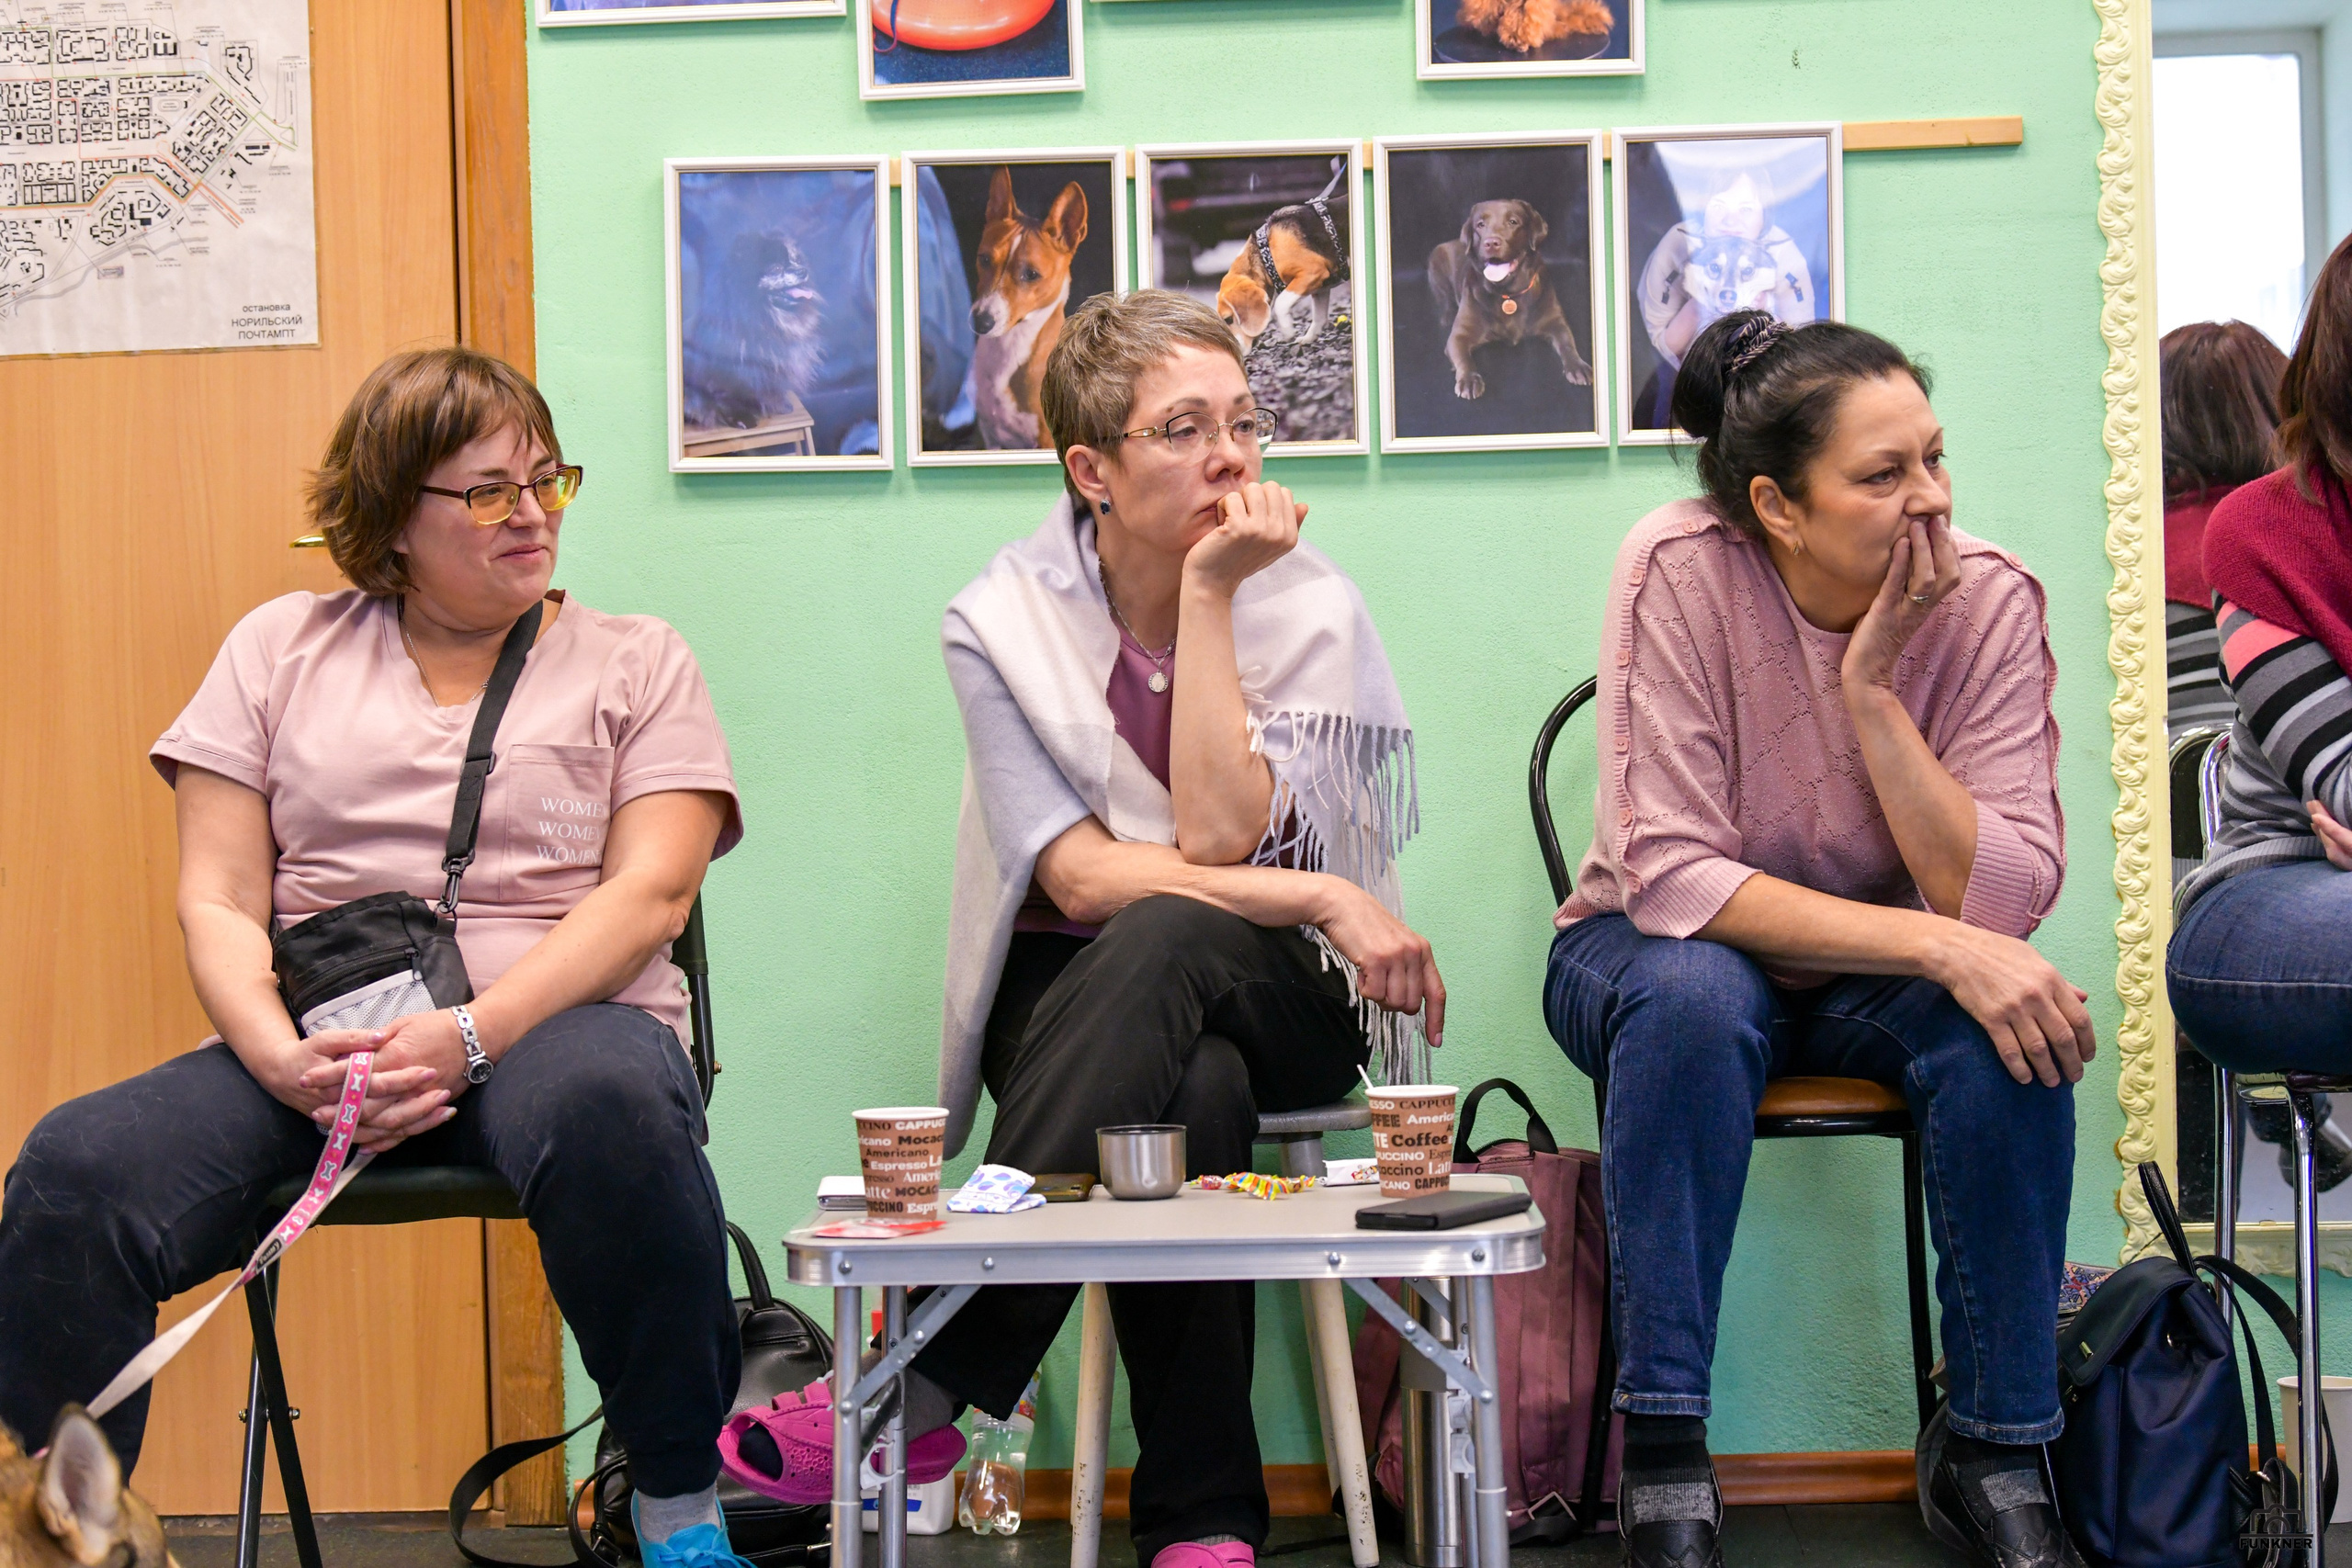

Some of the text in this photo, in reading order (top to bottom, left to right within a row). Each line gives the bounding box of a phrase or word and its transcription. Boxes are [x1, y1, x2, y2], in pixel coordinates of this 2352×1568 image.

[243, 304, 290, 312] остановка
[232, 314, 302, 327] НОРИЛЬСКИЙ
[238, 329, 296, 339] ПОЧТАМПТ
[1391, 1133, 1448, 1147] Coffee
[866, 1148, 930, 1157] Americano
[870, 1160, 928, 1172] Espresso
